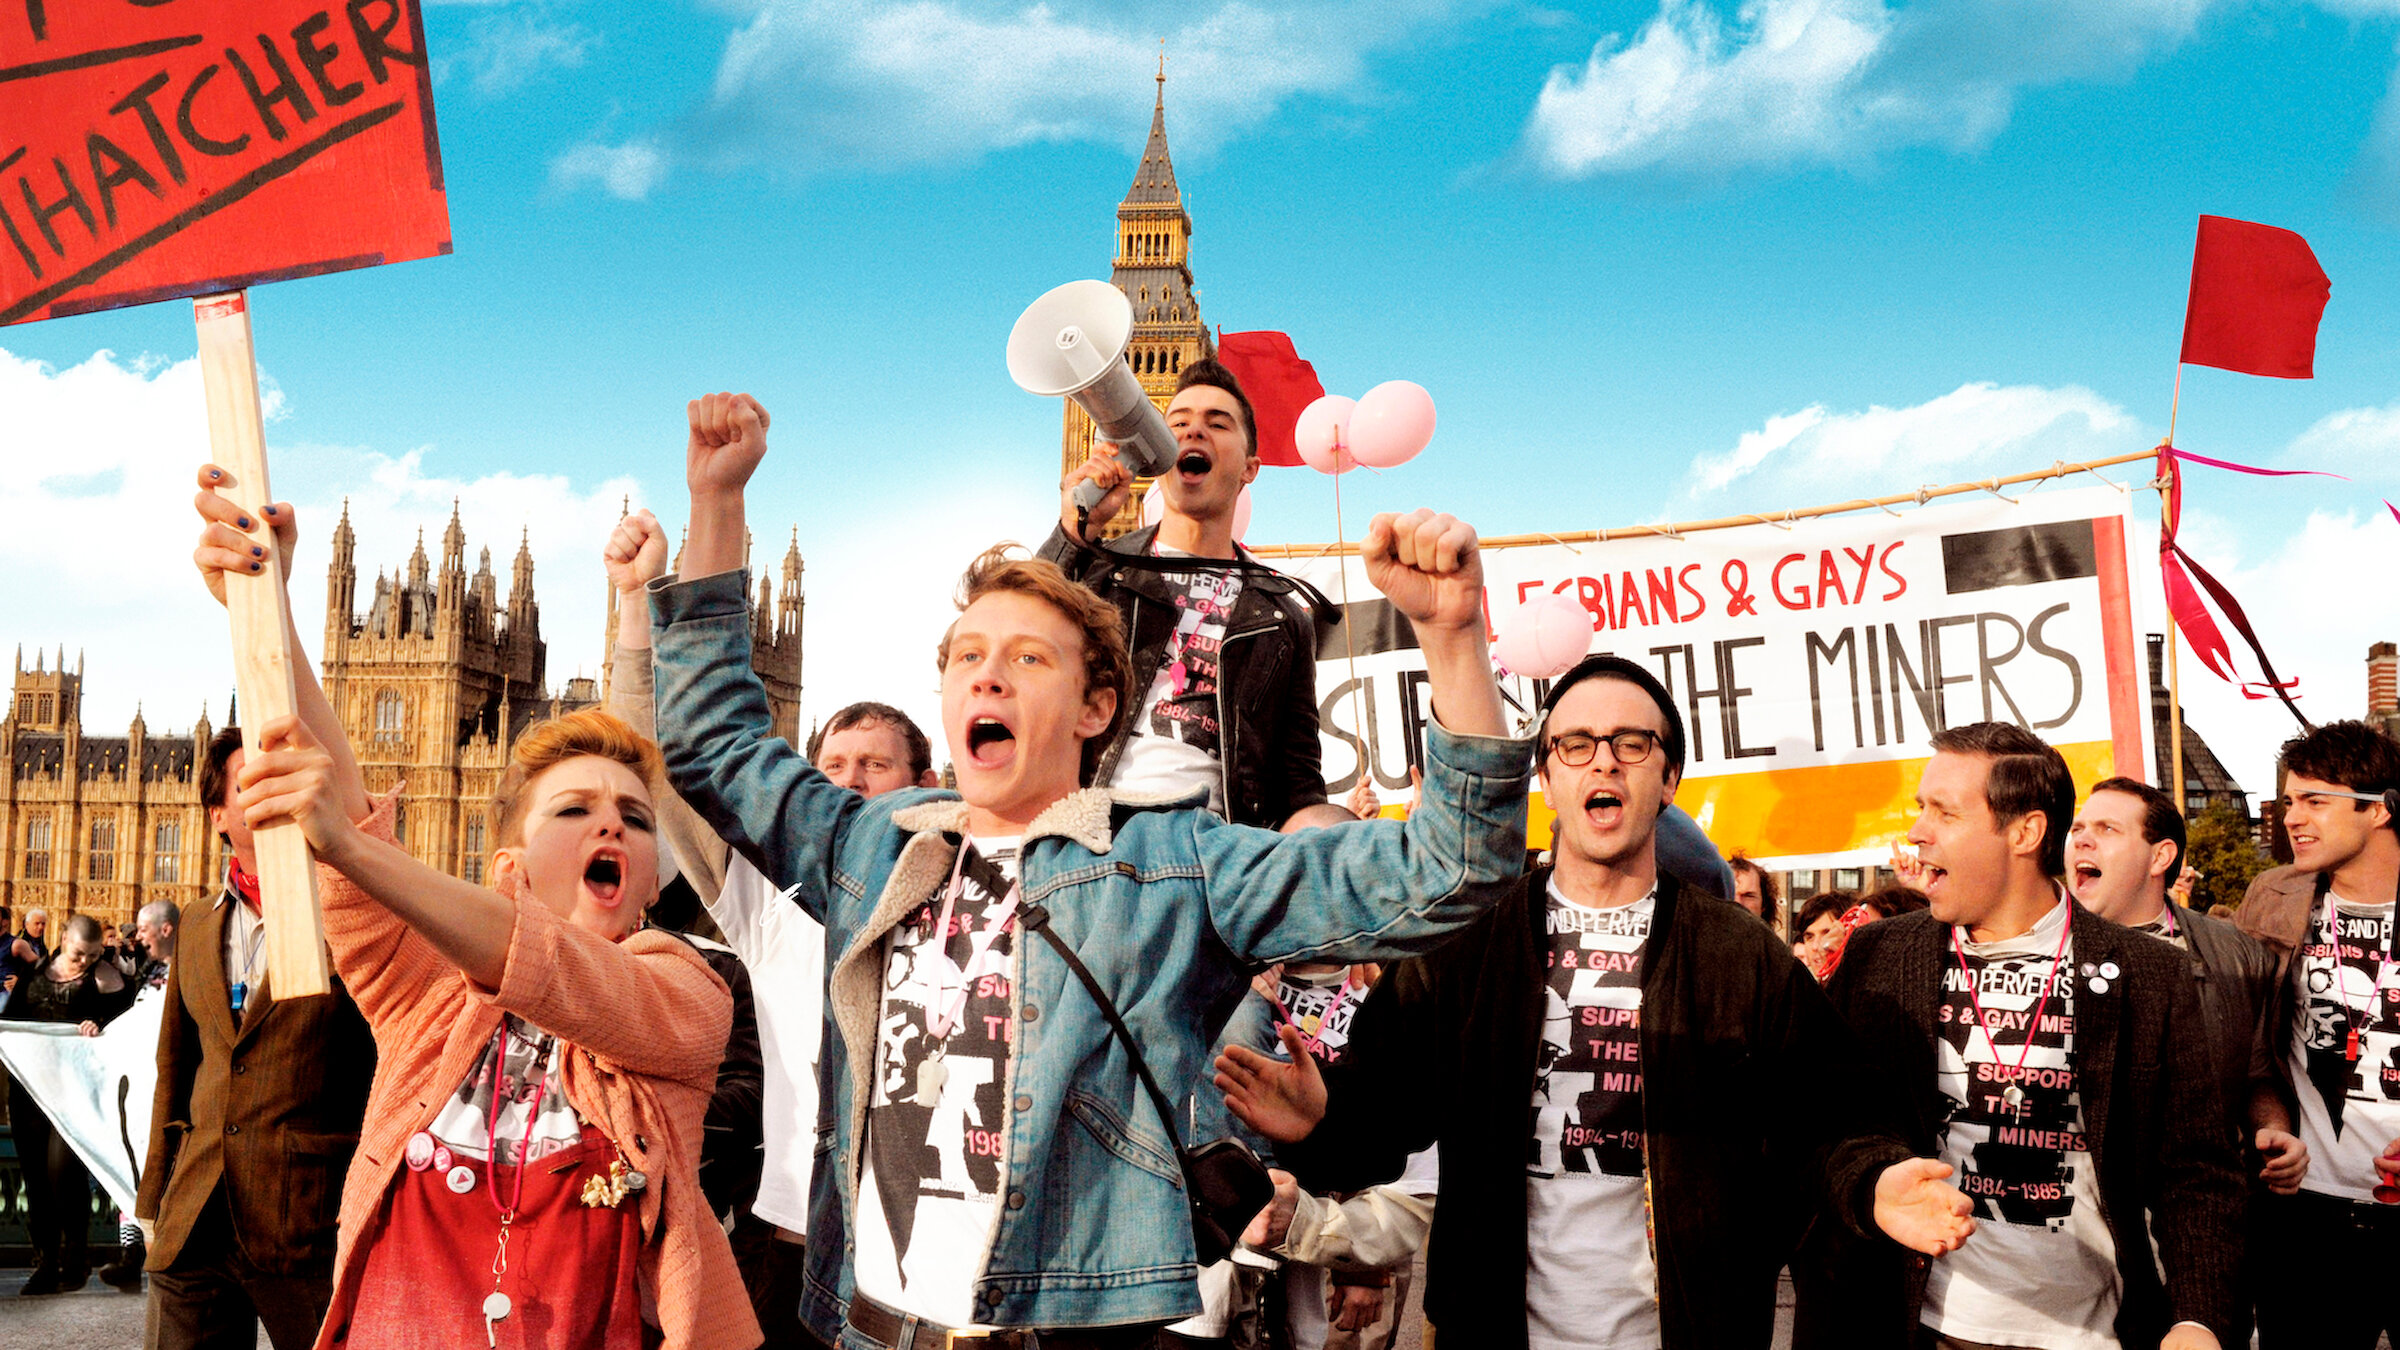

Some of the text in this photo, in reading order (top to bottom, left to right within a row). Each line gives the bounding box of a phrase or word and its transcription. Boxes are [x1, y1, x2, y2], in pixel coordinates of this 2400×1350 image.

[0, 0, 428, 281] THATCHER
[1722, 558, 1758, 617] &
[1771, 540, 1909, 609] GAYS
[1194, 599, 1231, 619] GAY
[1806, 601, 2081, 753] MINERS
[2346, 918, 2378, 940] AND
[1561, 949, 1579, 969] &
[1587, 950, 1640, 973] GAY
[1940, 967, 2074, 999] AND PERVERTS
[1959, 1006, 1976, 1025] &
[1984, 1008, 2031, 1031] GAY
[2040, 1013, 2077, 1034] ME
[1588, 1039, 1639, 1062] THE
[1997, 1125, 2088, 1152] MINERS
